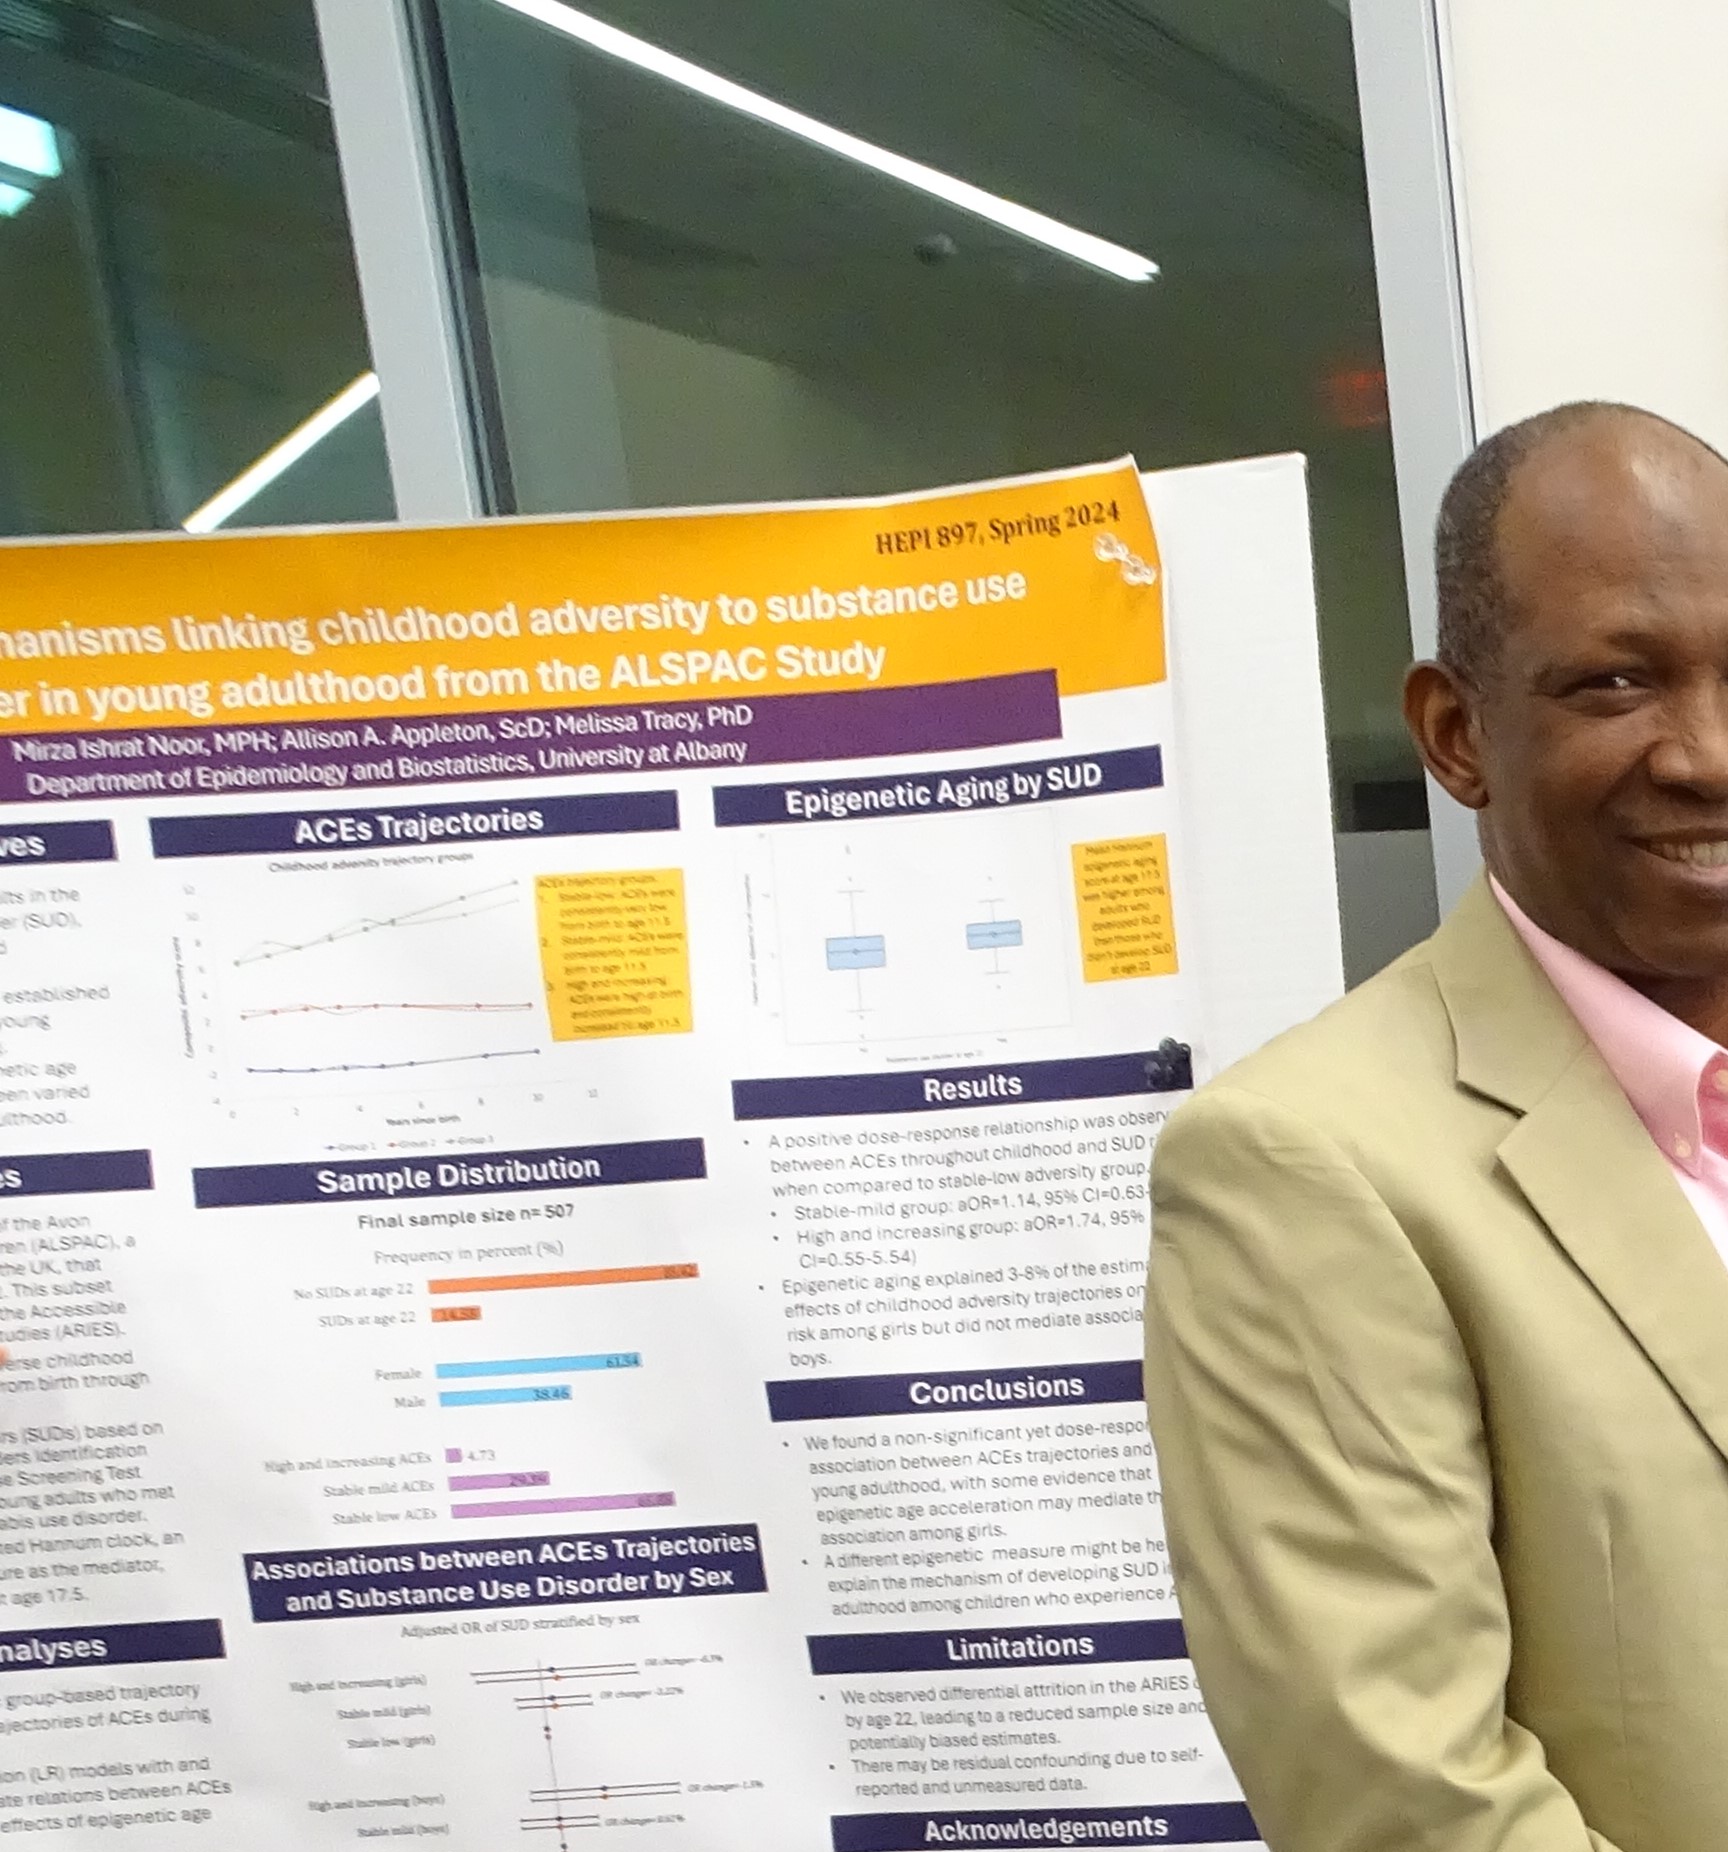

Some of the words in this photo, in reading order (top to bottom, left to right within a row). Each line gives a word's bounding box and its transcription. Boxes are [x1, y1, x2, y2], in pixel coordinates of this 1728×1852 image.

[875, 527, 932, 556] HEPI
[936, 520, 985, 549] 897,
[988, 512, 1062, 546] Spring
[1064, 499, 1121, 529] 2024
[170, 612, 316, 657] linking
[317, 601, 521, 647] childhood
[529, 592, 710, 637] adversity
[715, 593, 759, 626] to
[765, 580, 960, 624] substance
[965, 570, 1027, 606] use
[37, 680, 81, 718] in
[85, 679, 216, 724] young
[220, 664, 427, 709] adulthood
[431, 663, 530, 699] from
[535, 658, 602, 694] the
[609, 646, 768, 690] ALSPAC
[775, 639, 886, 682] Study
[10, 739, 78, 763] Mirza
[77, 736, 146, 760] Ishrat
[145, 733, 212, 758] Noor,
[212, 729, 279, 755] MPH;
[281, 726, 359, 751] Allison
[361, 724, 387, 748] A.
[390, 722, 496, 750] Appleton,
[498, 716, 552, 740] ScD;
[554, 712, 639, 736] Melissa
[640, 709, 704, 734] Tracy,
[706, 703, 754, 728] PhD
[26, 769, 167, 799] Department
[167, 766, 192, 790] of
[194, 761, 349, 792] Epidemiology
[351, 758, 395, 781] and
[396, 750, 536, 779] Biostatistics,
[537, 743, 645, 771] University
[647, 742, 671, 765] at
[673, 739, 748, 764] Albany
[784, 781, 931, 820] Epigenetic
[936, 774, 1010, 809] Aging
[1012, 771, 1042, 800] by
[1046, 761, 1103, 792] SUD
[295, 816, 373, 844] ACEs
[375, 807, 544, 843] Trajectories
[923, 1073, 1023, 1102] Results
[317, 1165, 432, 1196] Sample
[437, 1155, 601, 1188] Distribution
[909, 1374, 1085, 1406] Conclusions
[252, 1554, 415, 1582] Associations
[419, 1548, 534, 1572] between
[538, 1539, 609, 1564] ACEs
[613, 1533, 756, 1561] Trajectories
[285, 1589, 334, 1613] and
[336, 1584, 475, 1610] Substance
[478, 1579, 531, 1601] Use
[536, 1571, 650, 1598] Disorder
[654, 1569, 685, 1594] by
[689, 1566, 735, 1589] Sex
[946, 1633, 1095, 1662] Limitations
[855, 1780, 919, 1800] reported
[922, 1780, 951, 1796] and
[953, 1776, 1046, 1794] unmeasured
[1048, 1776, 1088, 1793] data.
[925, 1815, 1169, 1845] Acknowledgements
